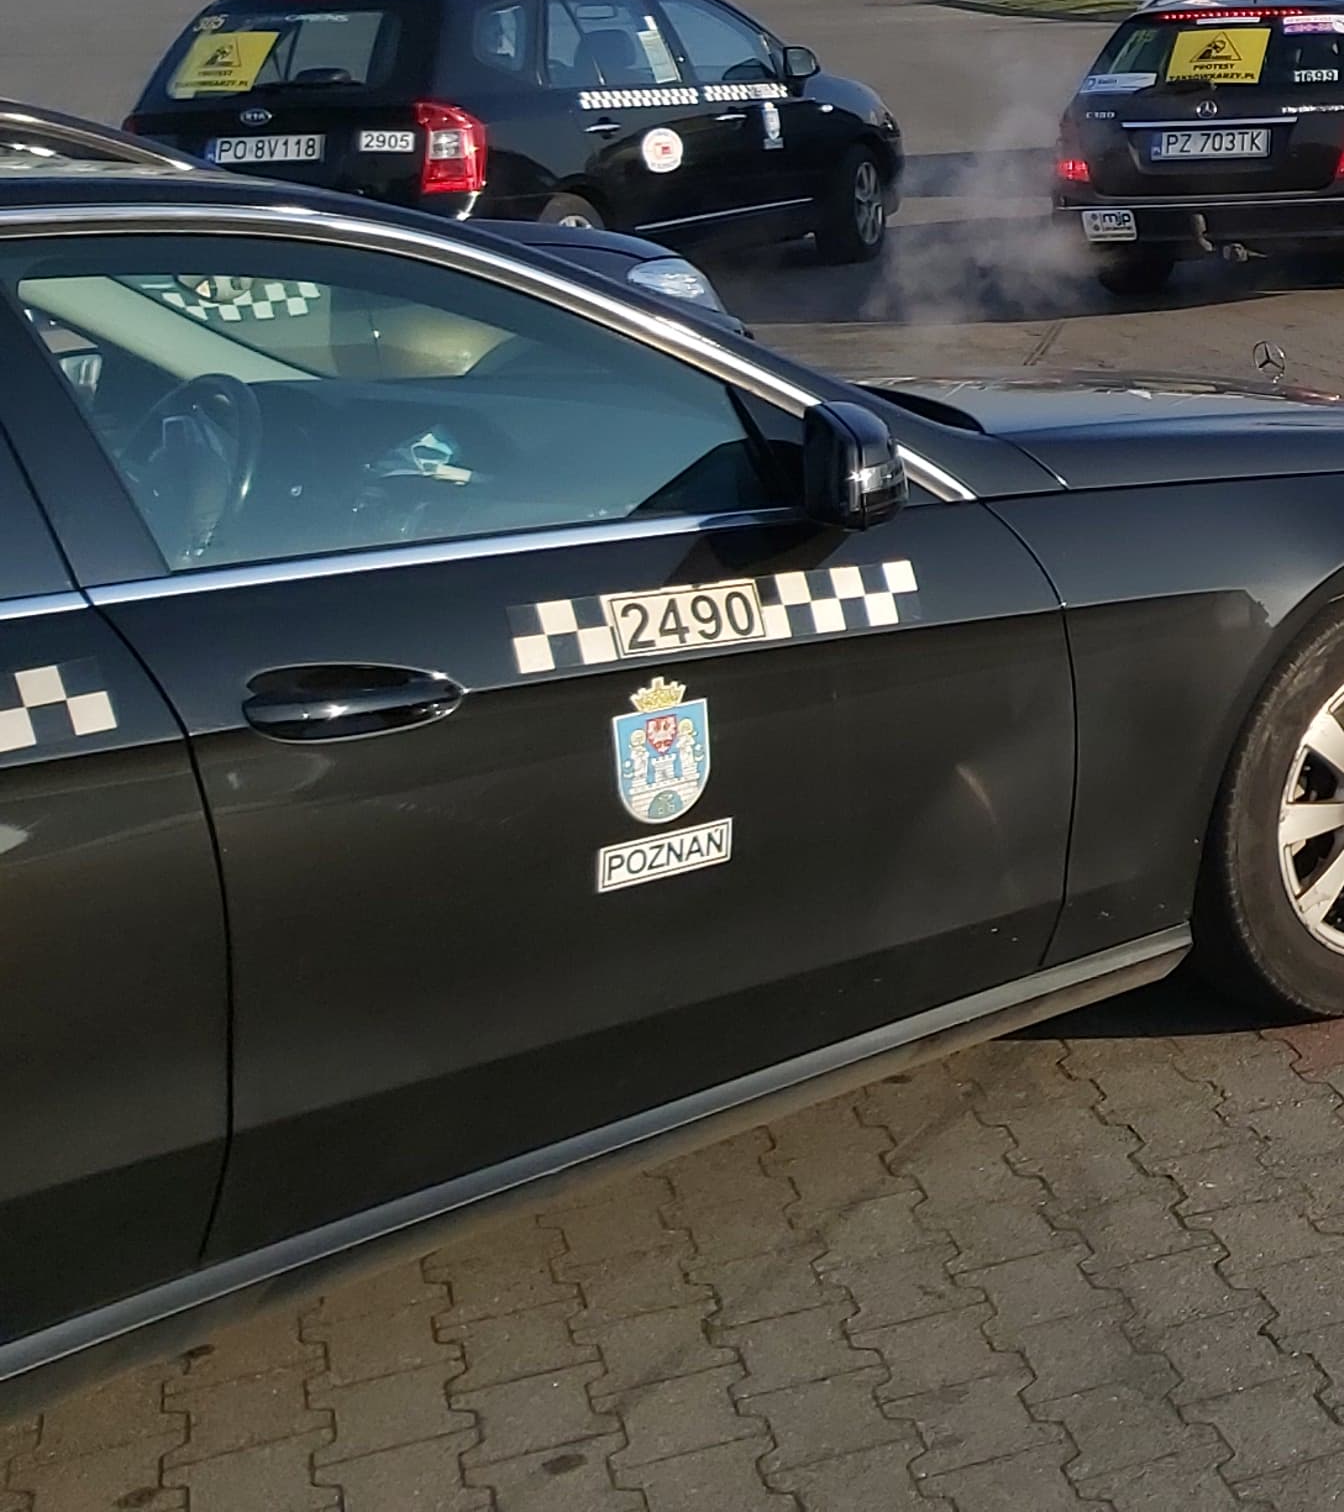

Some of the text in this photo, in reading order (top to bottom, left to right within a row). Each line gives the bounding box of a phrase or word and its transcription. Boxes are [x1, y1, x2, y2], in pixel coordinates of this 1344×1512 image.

[217, 137, 317, 161] PO 8V118
[363, 133, 410, 149] 2905
[1165, 131, 1263, 154] PZ 703TK
[619, 590, 756, 651] 2490
[605, 826, 726, 883] POZNAŃ
